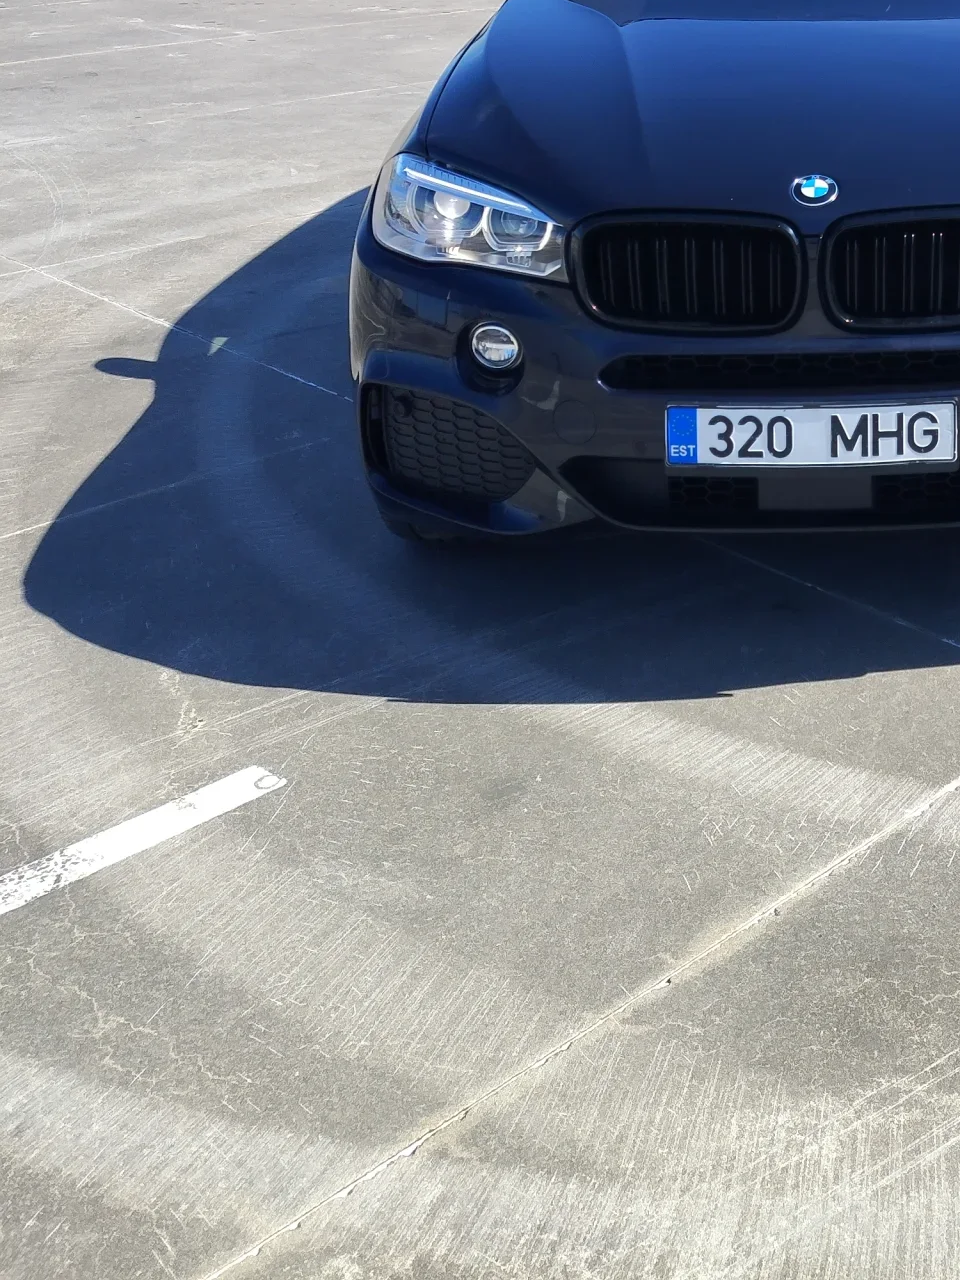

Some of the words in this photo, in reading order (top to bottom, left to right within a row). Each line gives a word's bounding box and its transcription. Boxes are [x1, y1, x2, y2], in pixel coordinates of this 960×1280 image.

[708, 415, 793, 458] 320
[830, 411, 939, 458] MHG
[671, 445, 696, 457] EST
